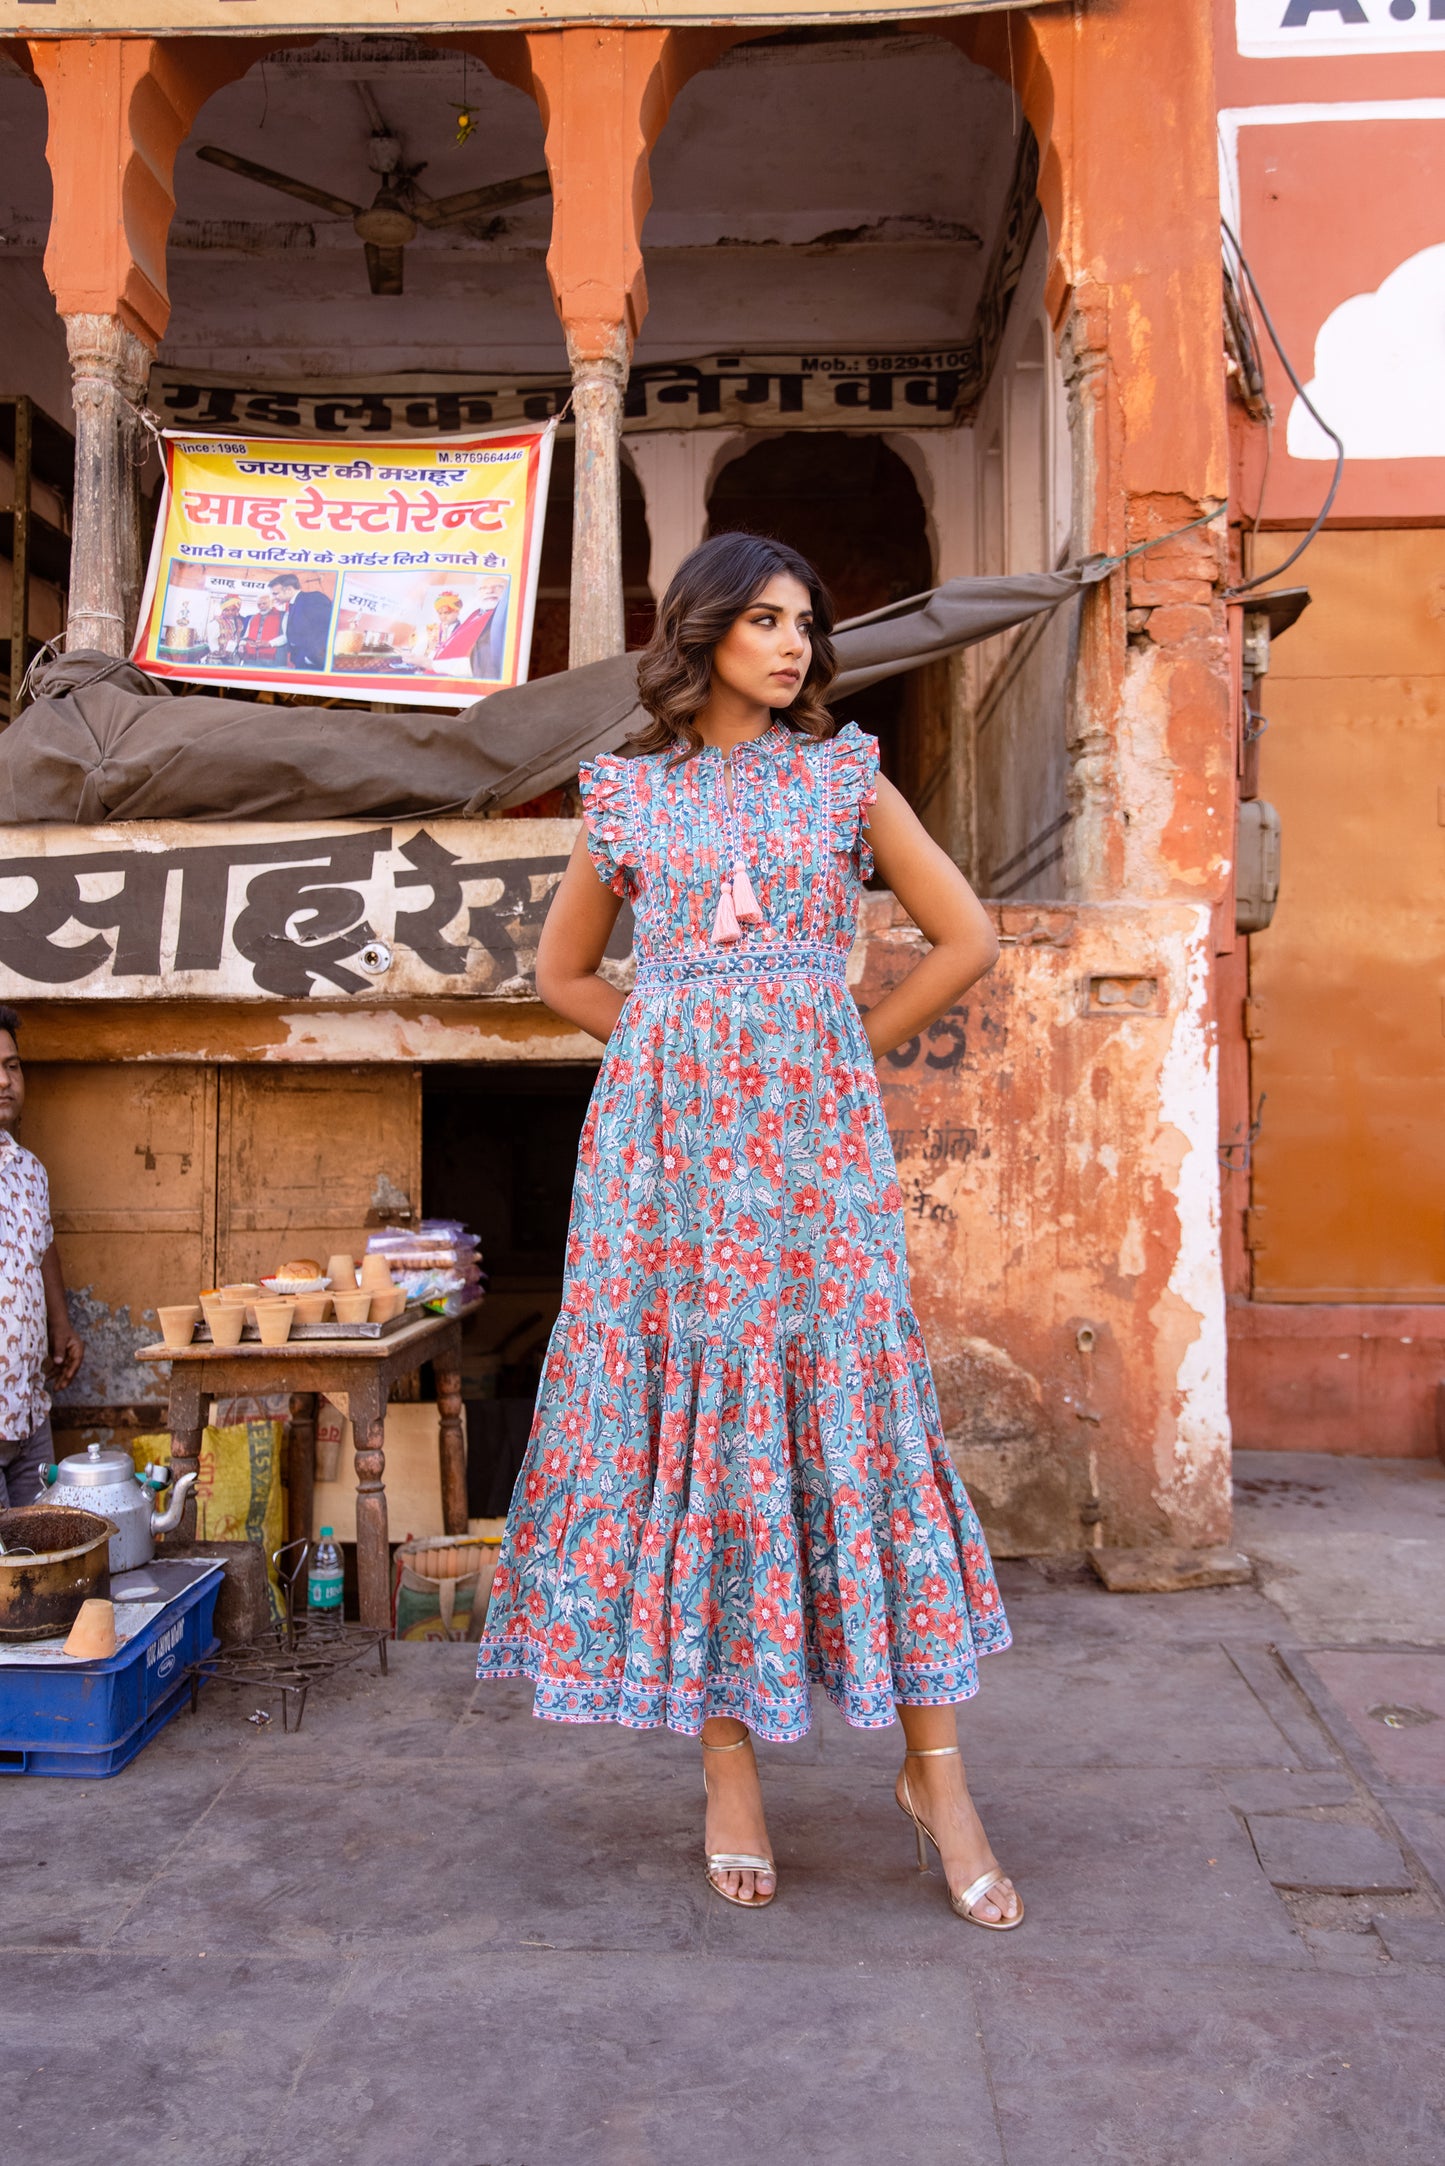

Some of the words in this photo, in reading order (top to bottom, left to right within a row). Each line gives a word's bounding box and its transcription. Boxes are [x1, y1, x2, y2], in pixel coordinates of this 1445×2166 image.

[161, 383, 498, 432] गुडलक
[218, 443, 246, 454] 1968
[236, 460, 328, 481] जयपुर
[334, 462, 373, 480] की
[378, 468, 468, 487] मशहूर
[184, 491, 287, 541] साहू
[296, 486, 510, 534] रेस्टोरेन्ट
[179, 544, 224, 558] शादी
[228, 549, 243, 559] व
[247, 547, 311, 562] पार्टियों
[313, 550, 335, 564] के
[393, 550, 432, 565] लिये
[435, 551, 479, 566] जाते
[210, 577, 236, 589] साहू
[241, 580, 266, 589] चाय
[348, 593, 378, 612] साहू
[0, 827, 392, 997] साहू
